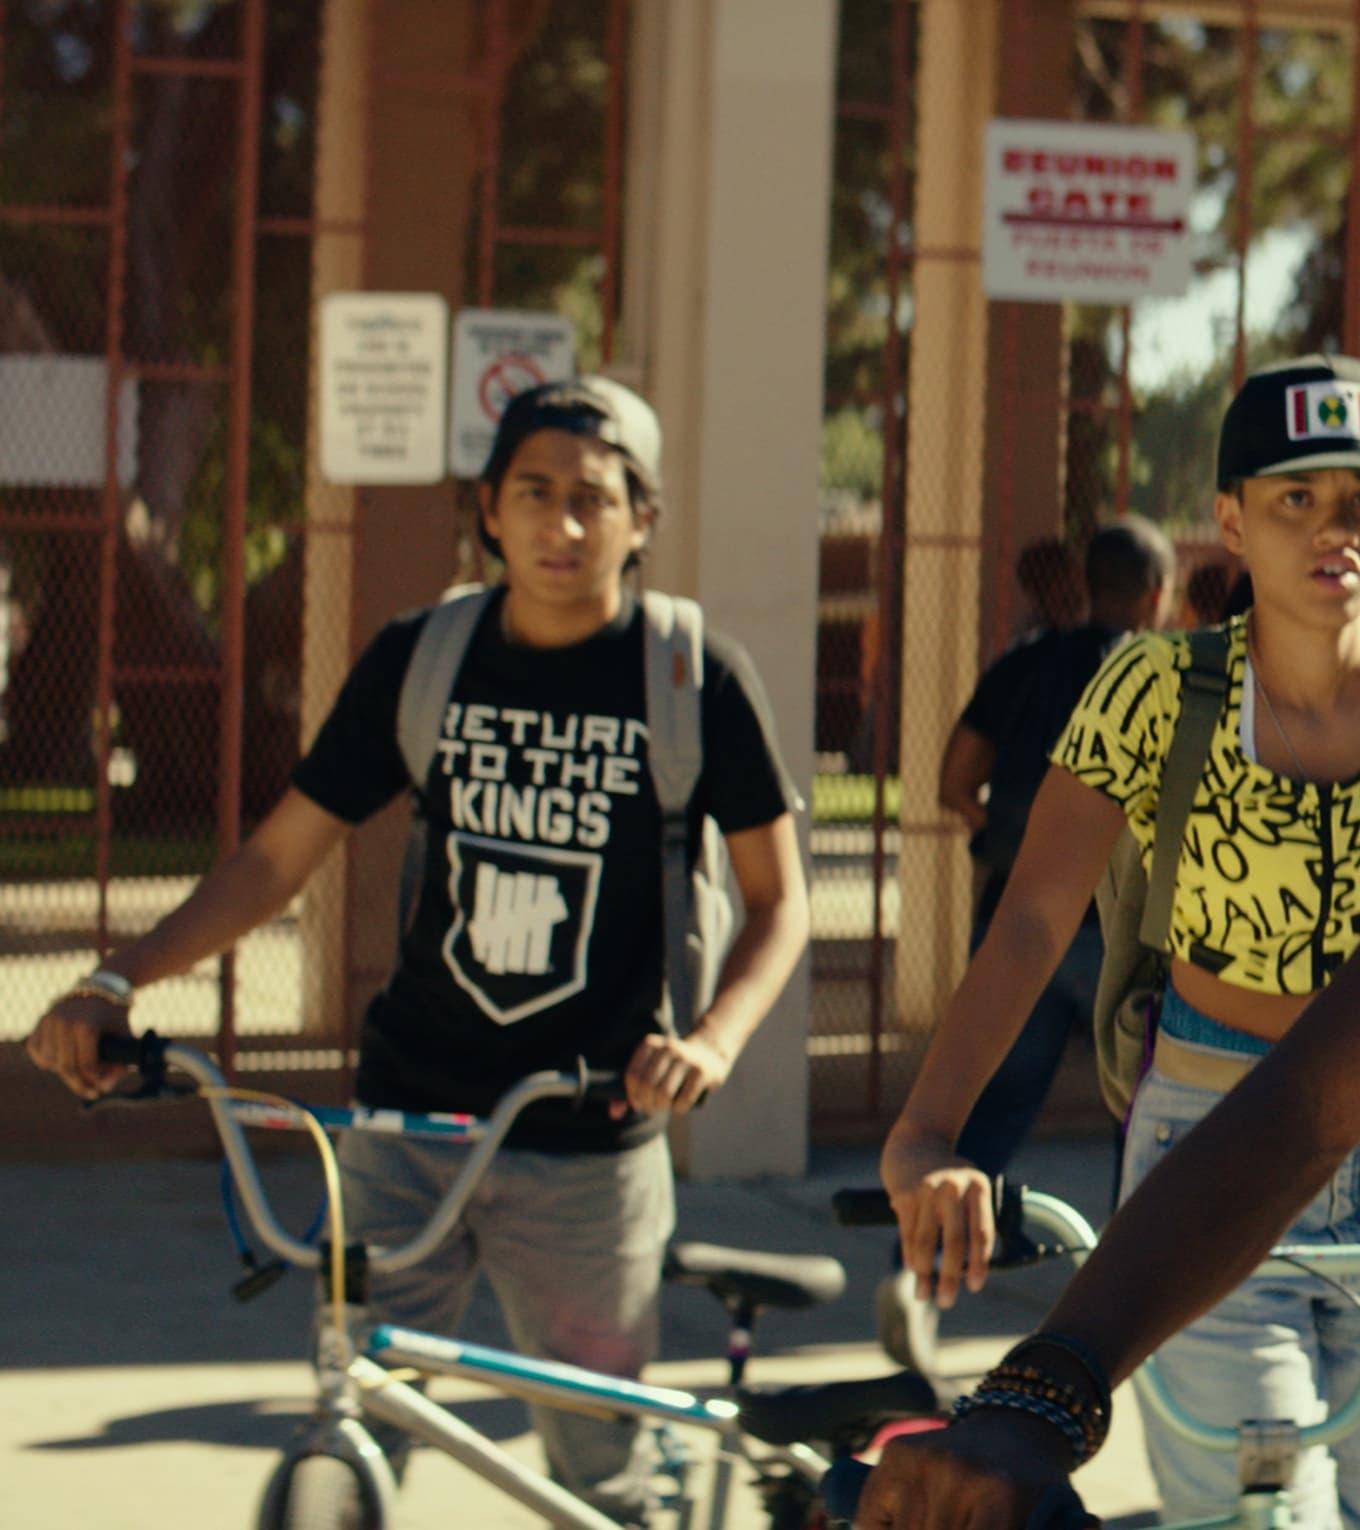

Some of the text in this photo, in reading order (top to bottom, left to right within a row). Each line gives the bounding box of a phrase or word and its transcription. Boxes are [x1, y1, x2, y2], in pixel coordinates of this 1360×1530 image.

[1003, 150, 1177, 181] REUNION
[1027, 187, 1153, 221] GATE
[438, 739, 641, 796] TO THE
[450, 776, 614, 849] KINGS
